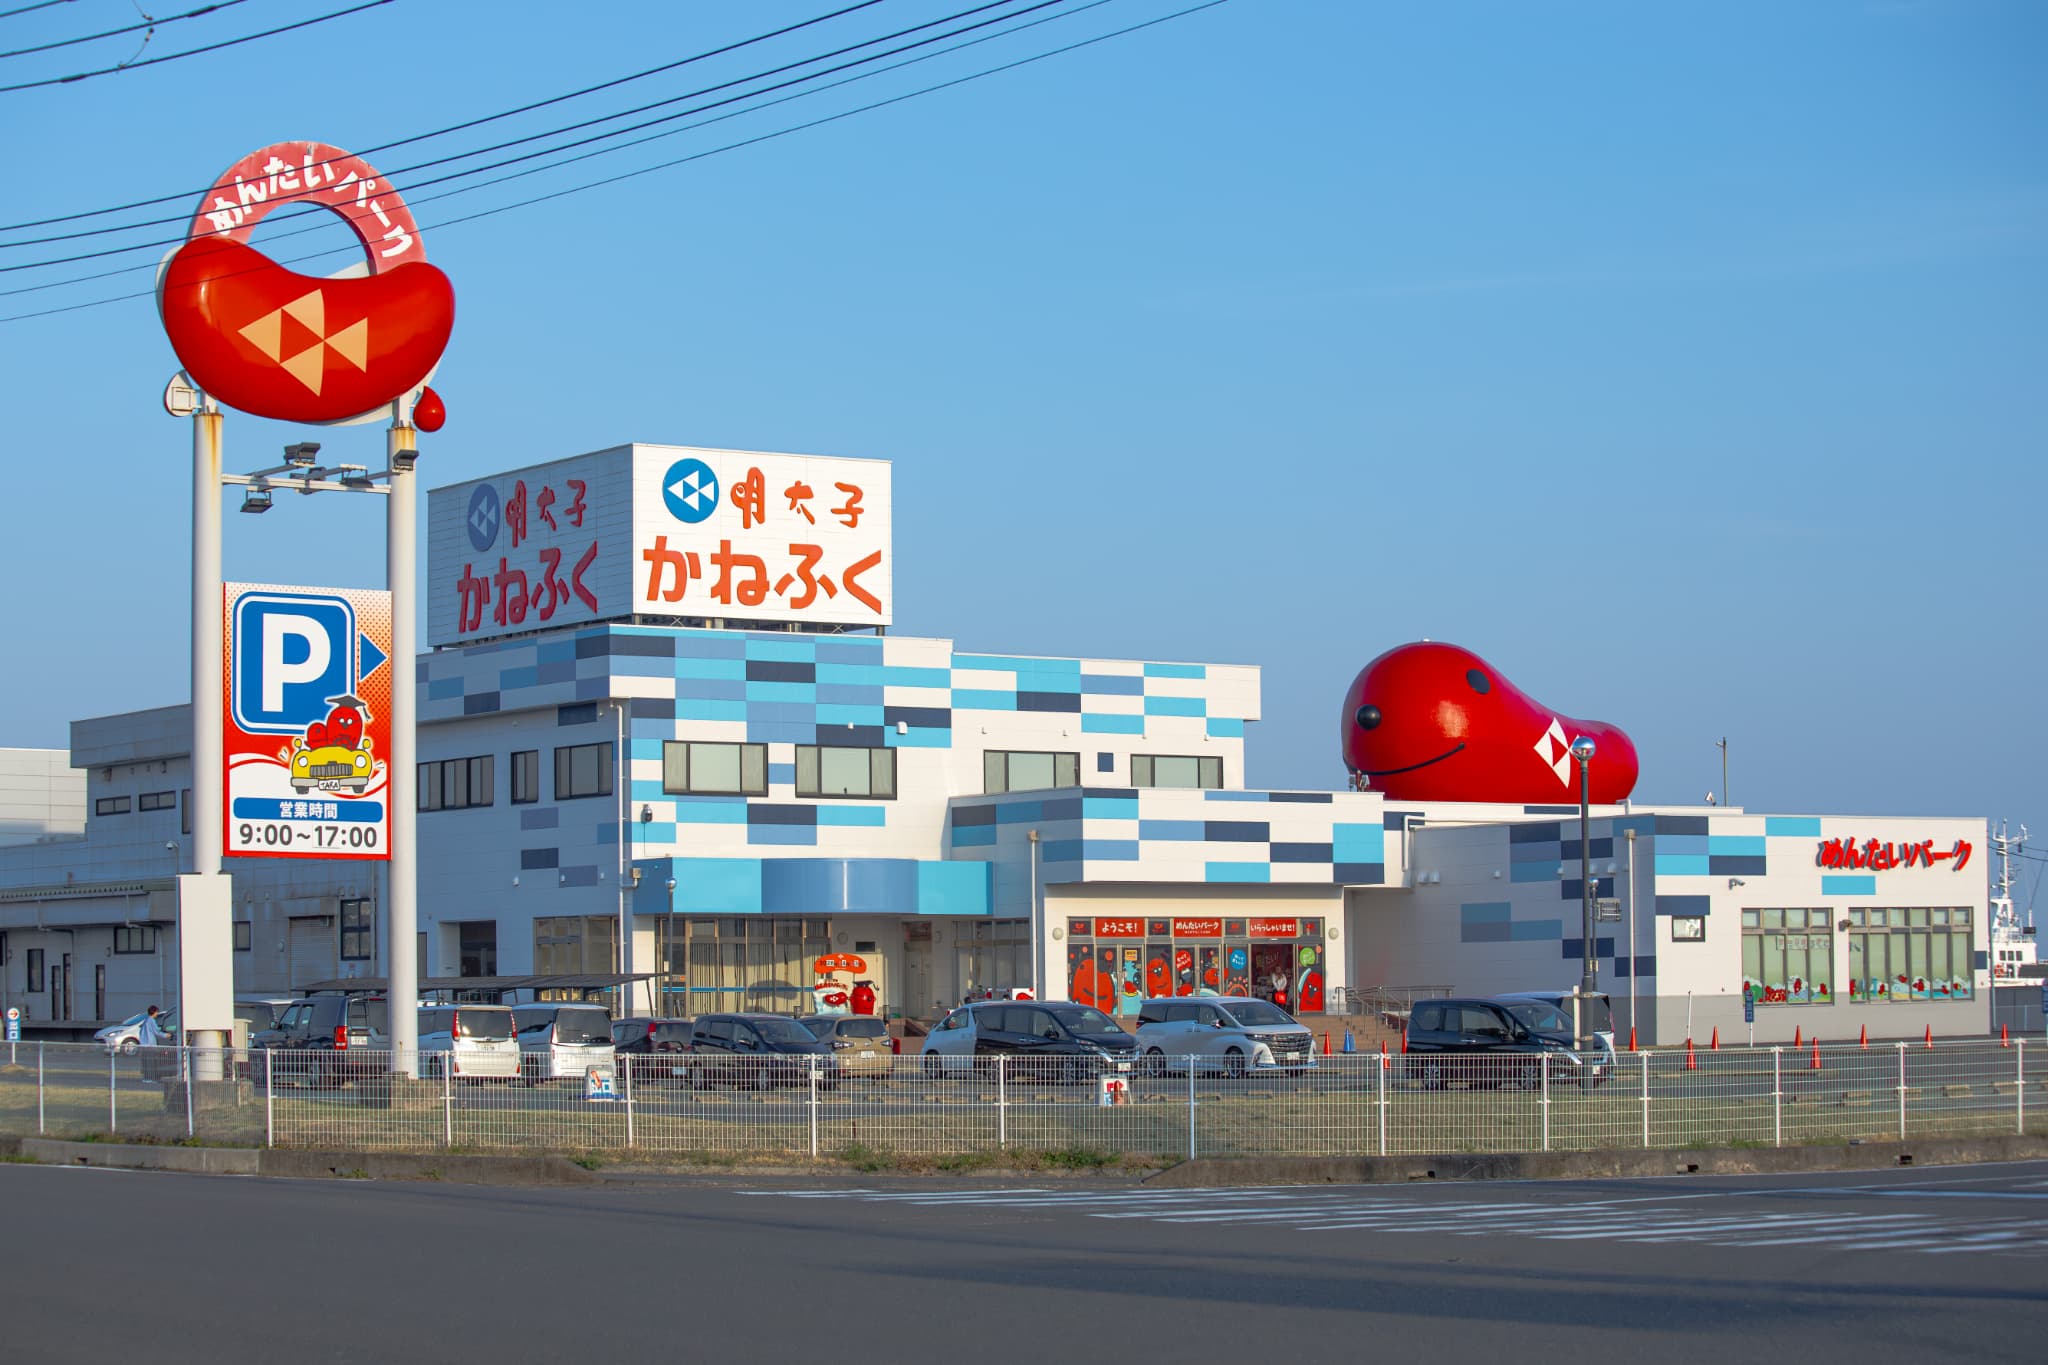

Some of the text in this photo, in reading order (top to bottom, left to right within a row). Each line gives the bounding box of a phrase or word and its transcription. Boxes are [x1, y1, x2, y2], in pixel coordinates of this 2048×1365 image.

[205, 154, 413, 258] めんたいパーク
[730, 467, 865, 529] 明太子
[457, 540, 598, 633] かねふく
[643, 535, 882, 615] かねふく
[262, 613, 331, 712] P
[279, 802, 338, 819] 営業時間
[1818, 836, 1973, 871] めんたいパーク
[1101, 922, 1138, 933] ようこそ!
[1175, 921, 1219, 930] めんたいパーク
[1250, 922, 1295, 932] いらっしゃいませ!
